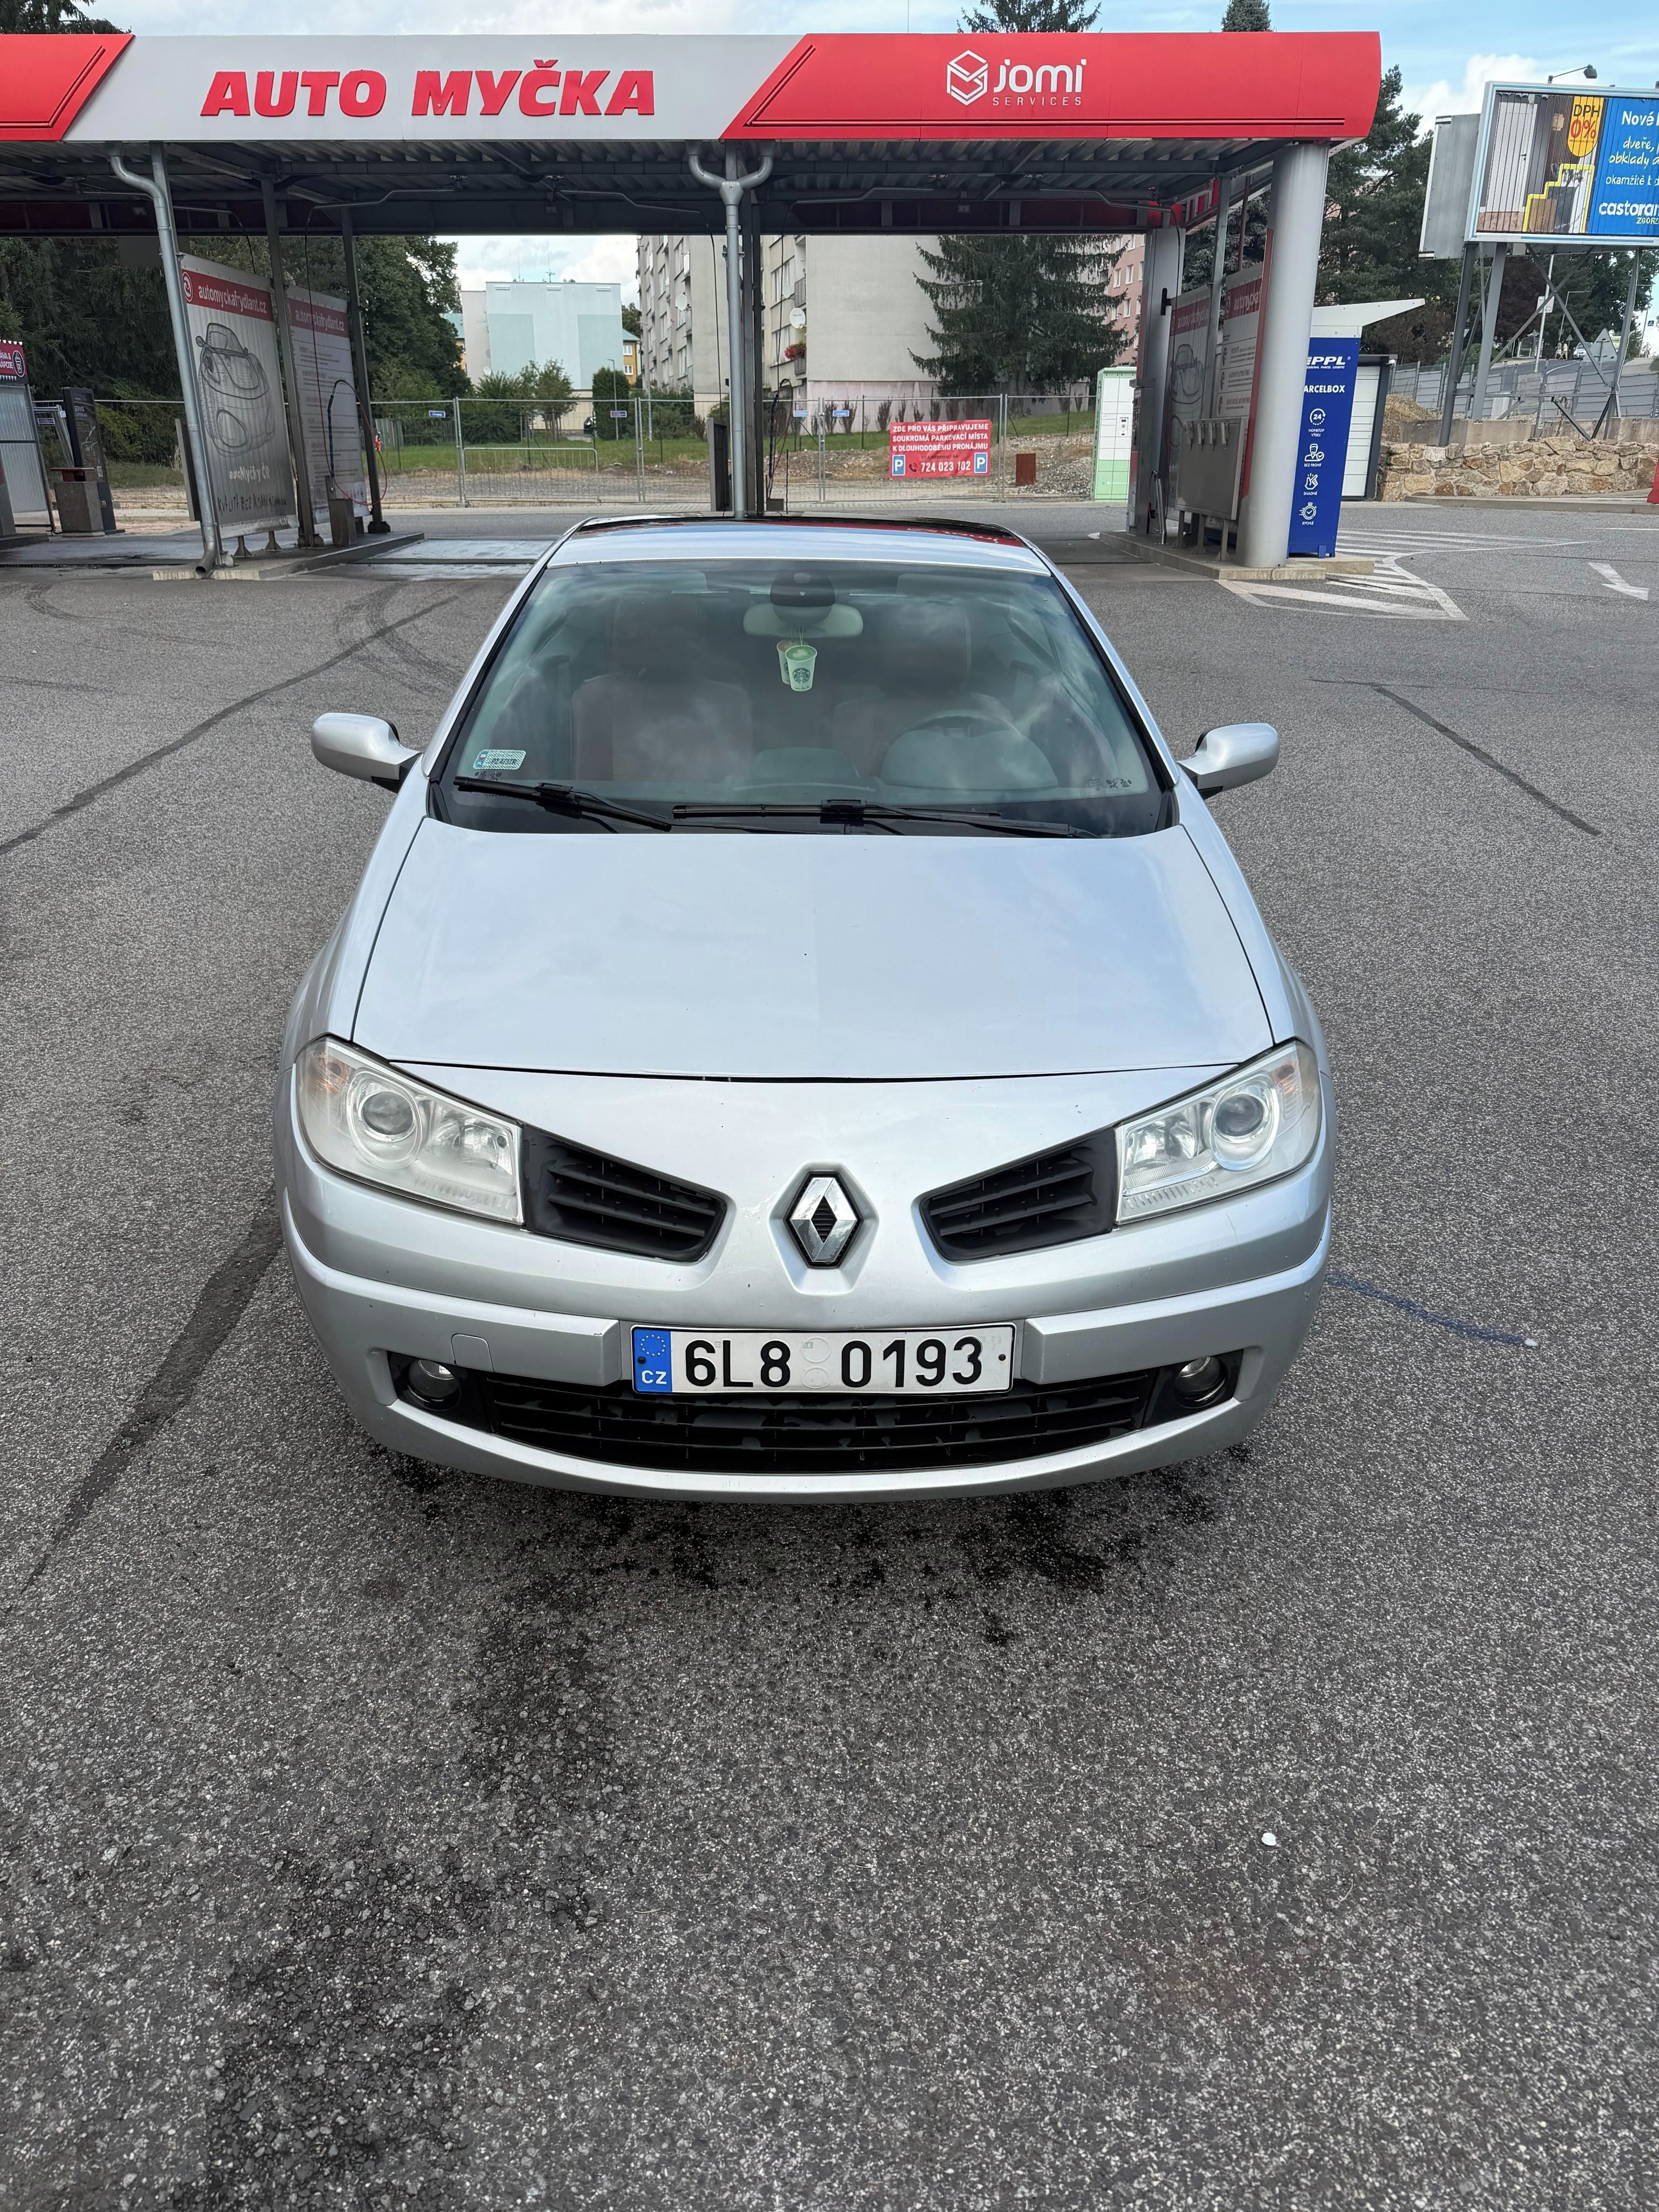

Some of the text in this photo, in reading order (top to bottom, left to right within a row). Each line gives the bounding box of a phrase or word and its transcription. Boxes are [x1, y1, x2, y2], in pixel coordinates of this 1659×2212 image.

[993, 58, 1087, 93] jomi
[200, 59, 655, 118] AUTO MYČKA
[993, 97, 1081, 106] SERVICES
[1573, 104, 1601, 118] DPH
[1621, 111, 1655, 126] Nové
[1570, 119, 1597, 139] 0%
[1608, 151, 1649, 169] obklady
[198, 284, 267, 314] automyckafrydlant.cz
[1311, 356, 1346, 366] PPL
[1304, 385, 1345, 393] ARCELBOX
[923, 423, 936, 432] VÁS
[938, 423, 989, 432] PŘIPRAVUJEME
[892, 432, 988, 442] SOUKROMÁ PARKOVACÍ MÍSTA
[898, 443, 951, 451] DLOUHODOBÉMU
[953, 442, 988, 450] PRONÁJMU
[894, 459, 903, 471] P
[920, 461, 971, 472] 724 023 102
[976, 457, 986, 469] P
[685, 1336, 983, 1388] 6L8 0193
[641, 1370, 667, 1385] CZ
